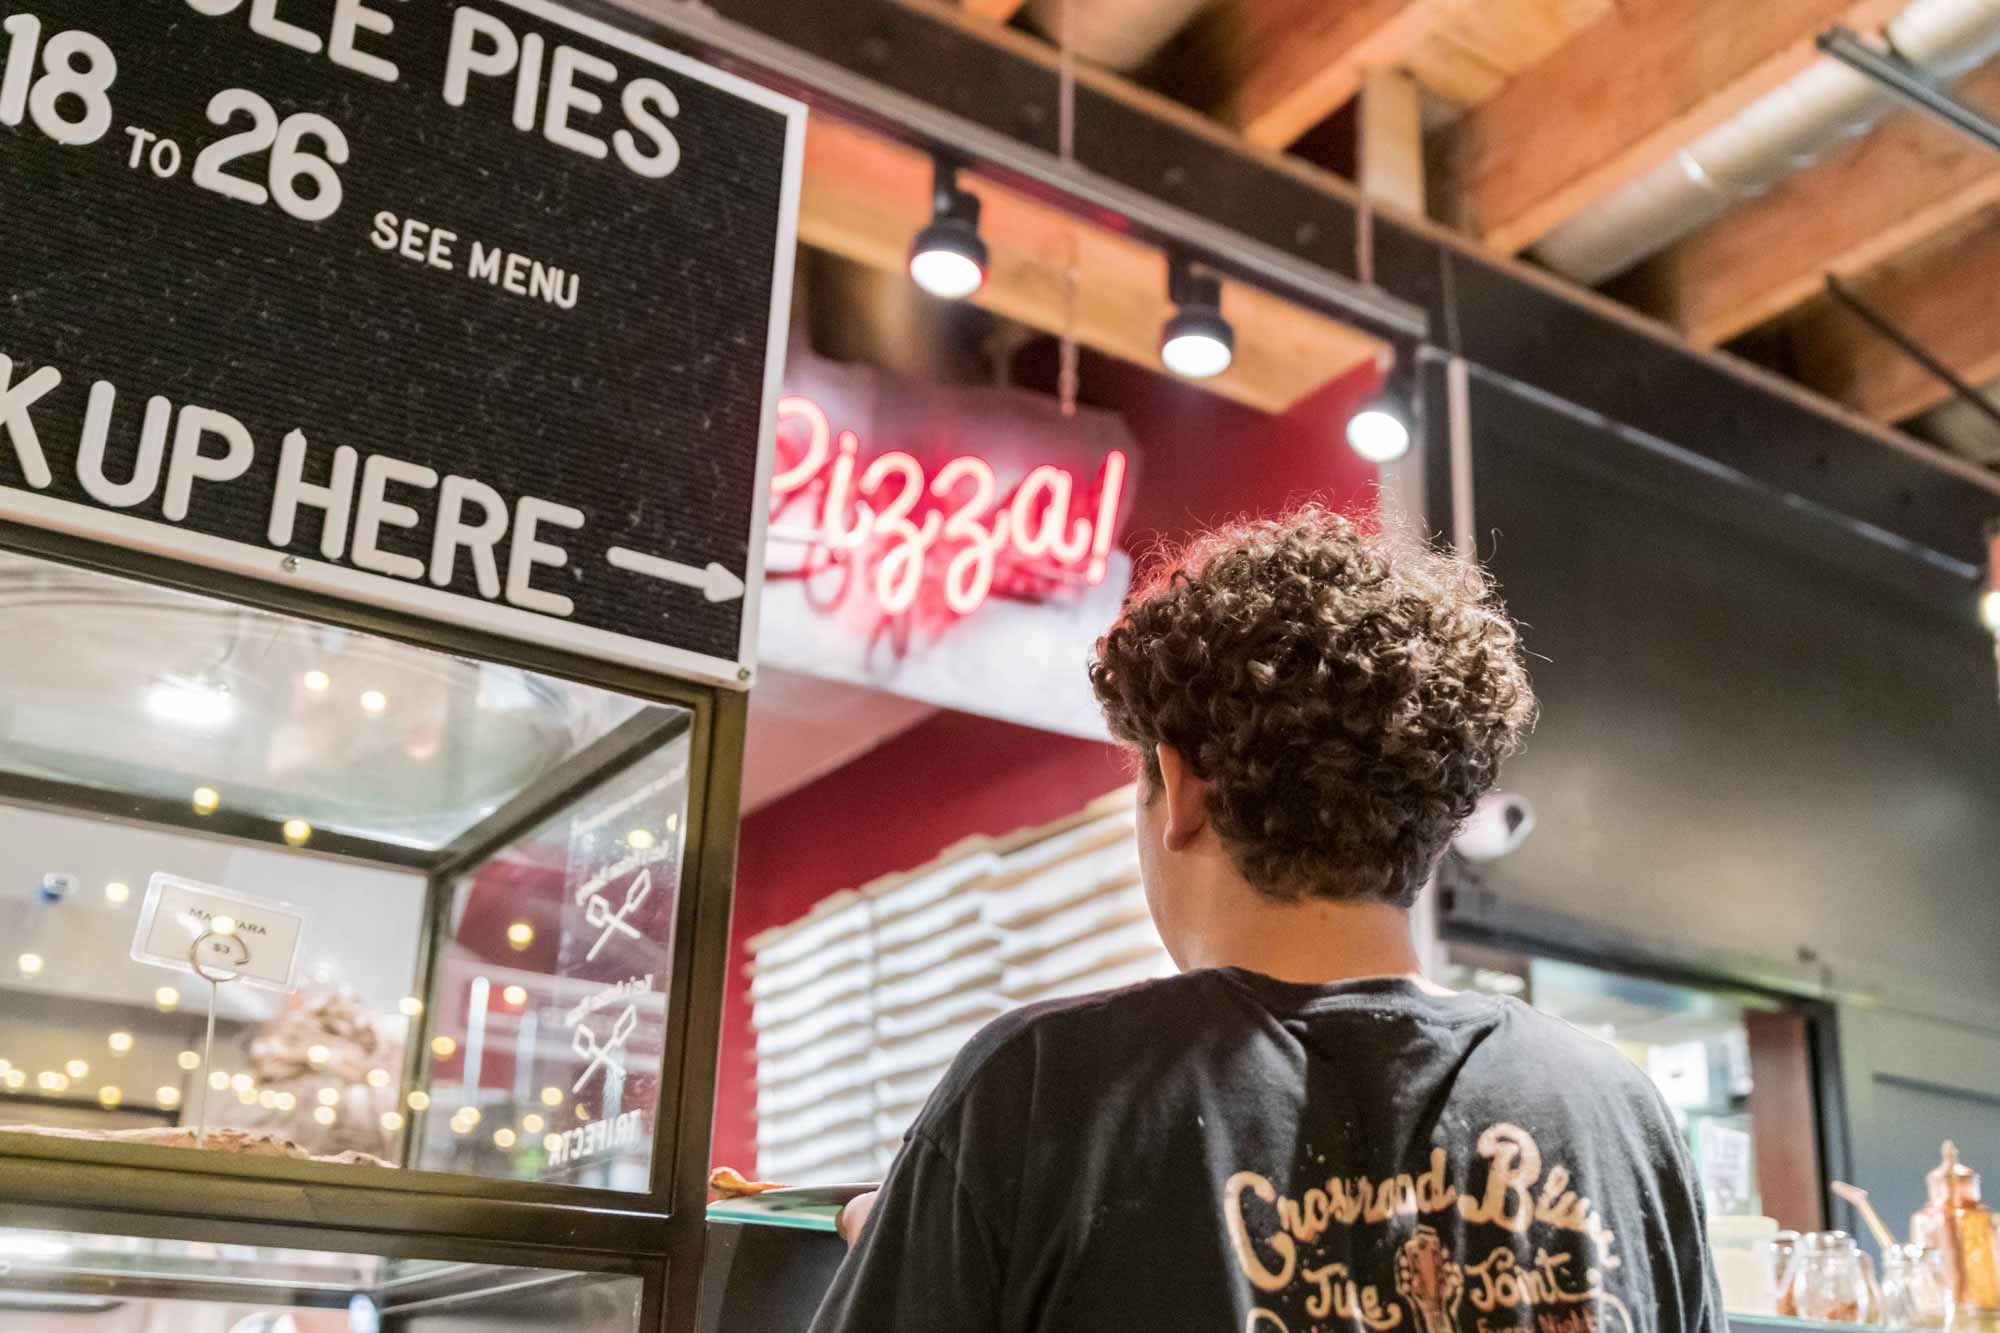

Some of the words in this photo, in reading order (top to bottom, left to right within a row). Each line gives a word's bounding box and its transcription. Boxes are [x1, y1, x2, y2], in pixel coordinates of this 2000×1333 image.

[0, 14, 117, 146] 18
[126, 126, 181, 178] TO
[193, 89, 349, 222] 26
[371, 211, 457, 270] SEE
[469, 242, 579, 308] MENU
[444, 7, 680, 178] PIES
[76, 381, 254, 522] UP
[268, 428, 584, 616] HERE
[189, 908, 267, 935] MAARA
[1302, 1263, 1401, 1331] Jue
